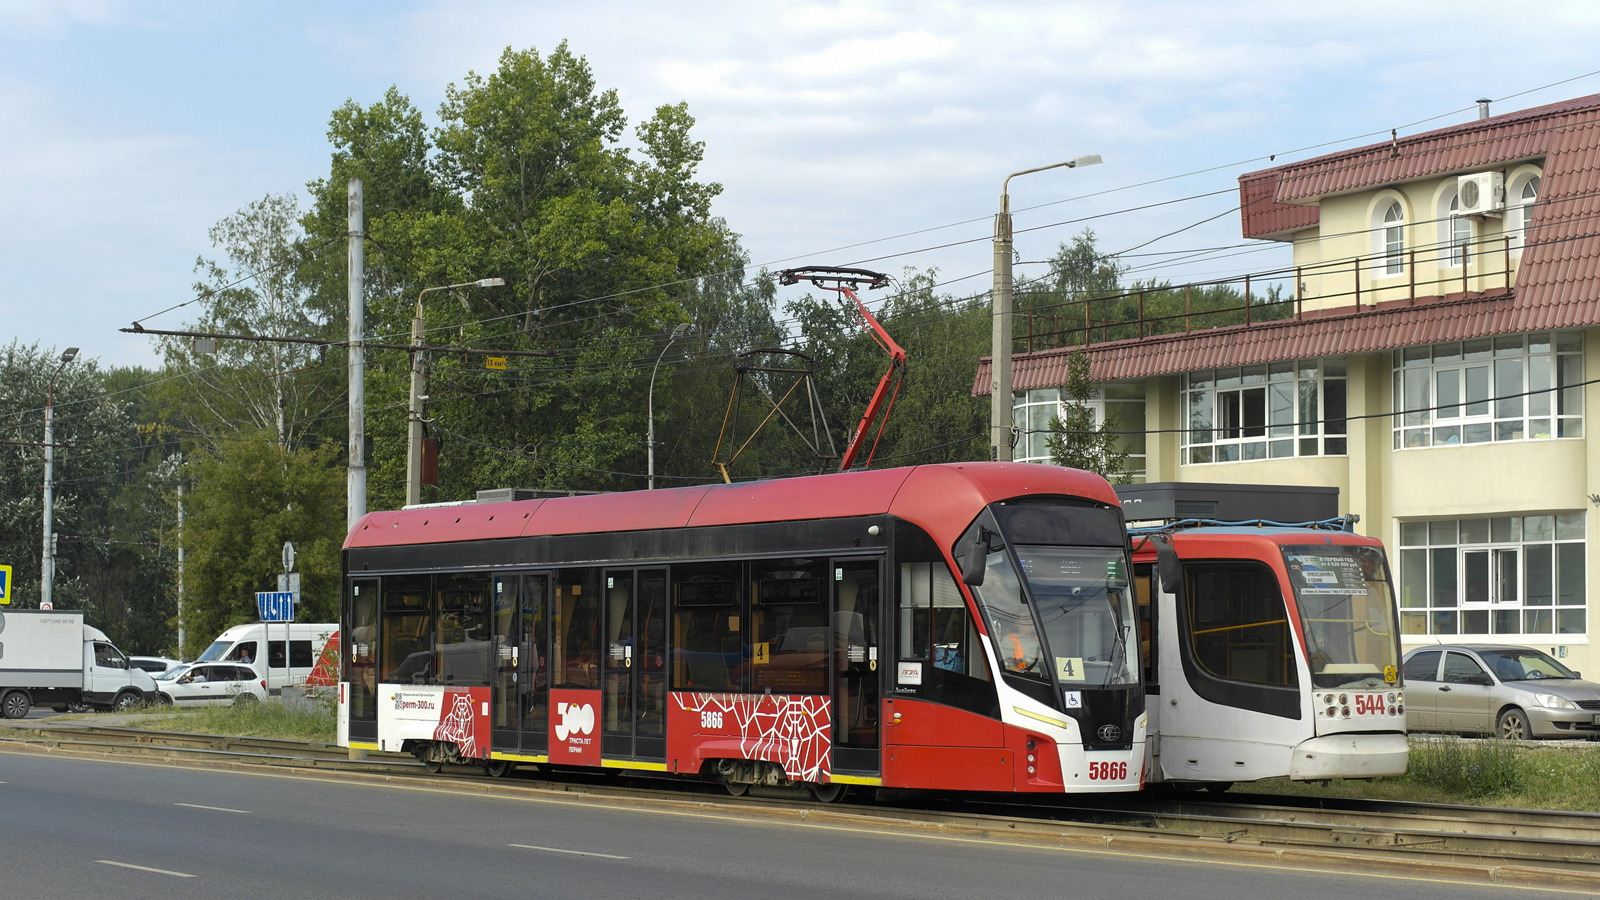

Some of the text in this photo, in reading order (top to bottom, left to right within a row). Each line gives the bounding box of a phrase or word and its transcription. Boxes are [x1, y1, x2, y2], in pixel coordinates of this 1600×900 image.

[757, 644, 763, 660] 4
[1063, 659, 1074, 676] 4
[402, 700, 435, 710] perm-300.ru
[1355, 694, 1385, 715] 544
[555, 702, 595, 741] 300
[701, 711, 723, 729] 5866
[1089, 762, 1127, 780] 5866
